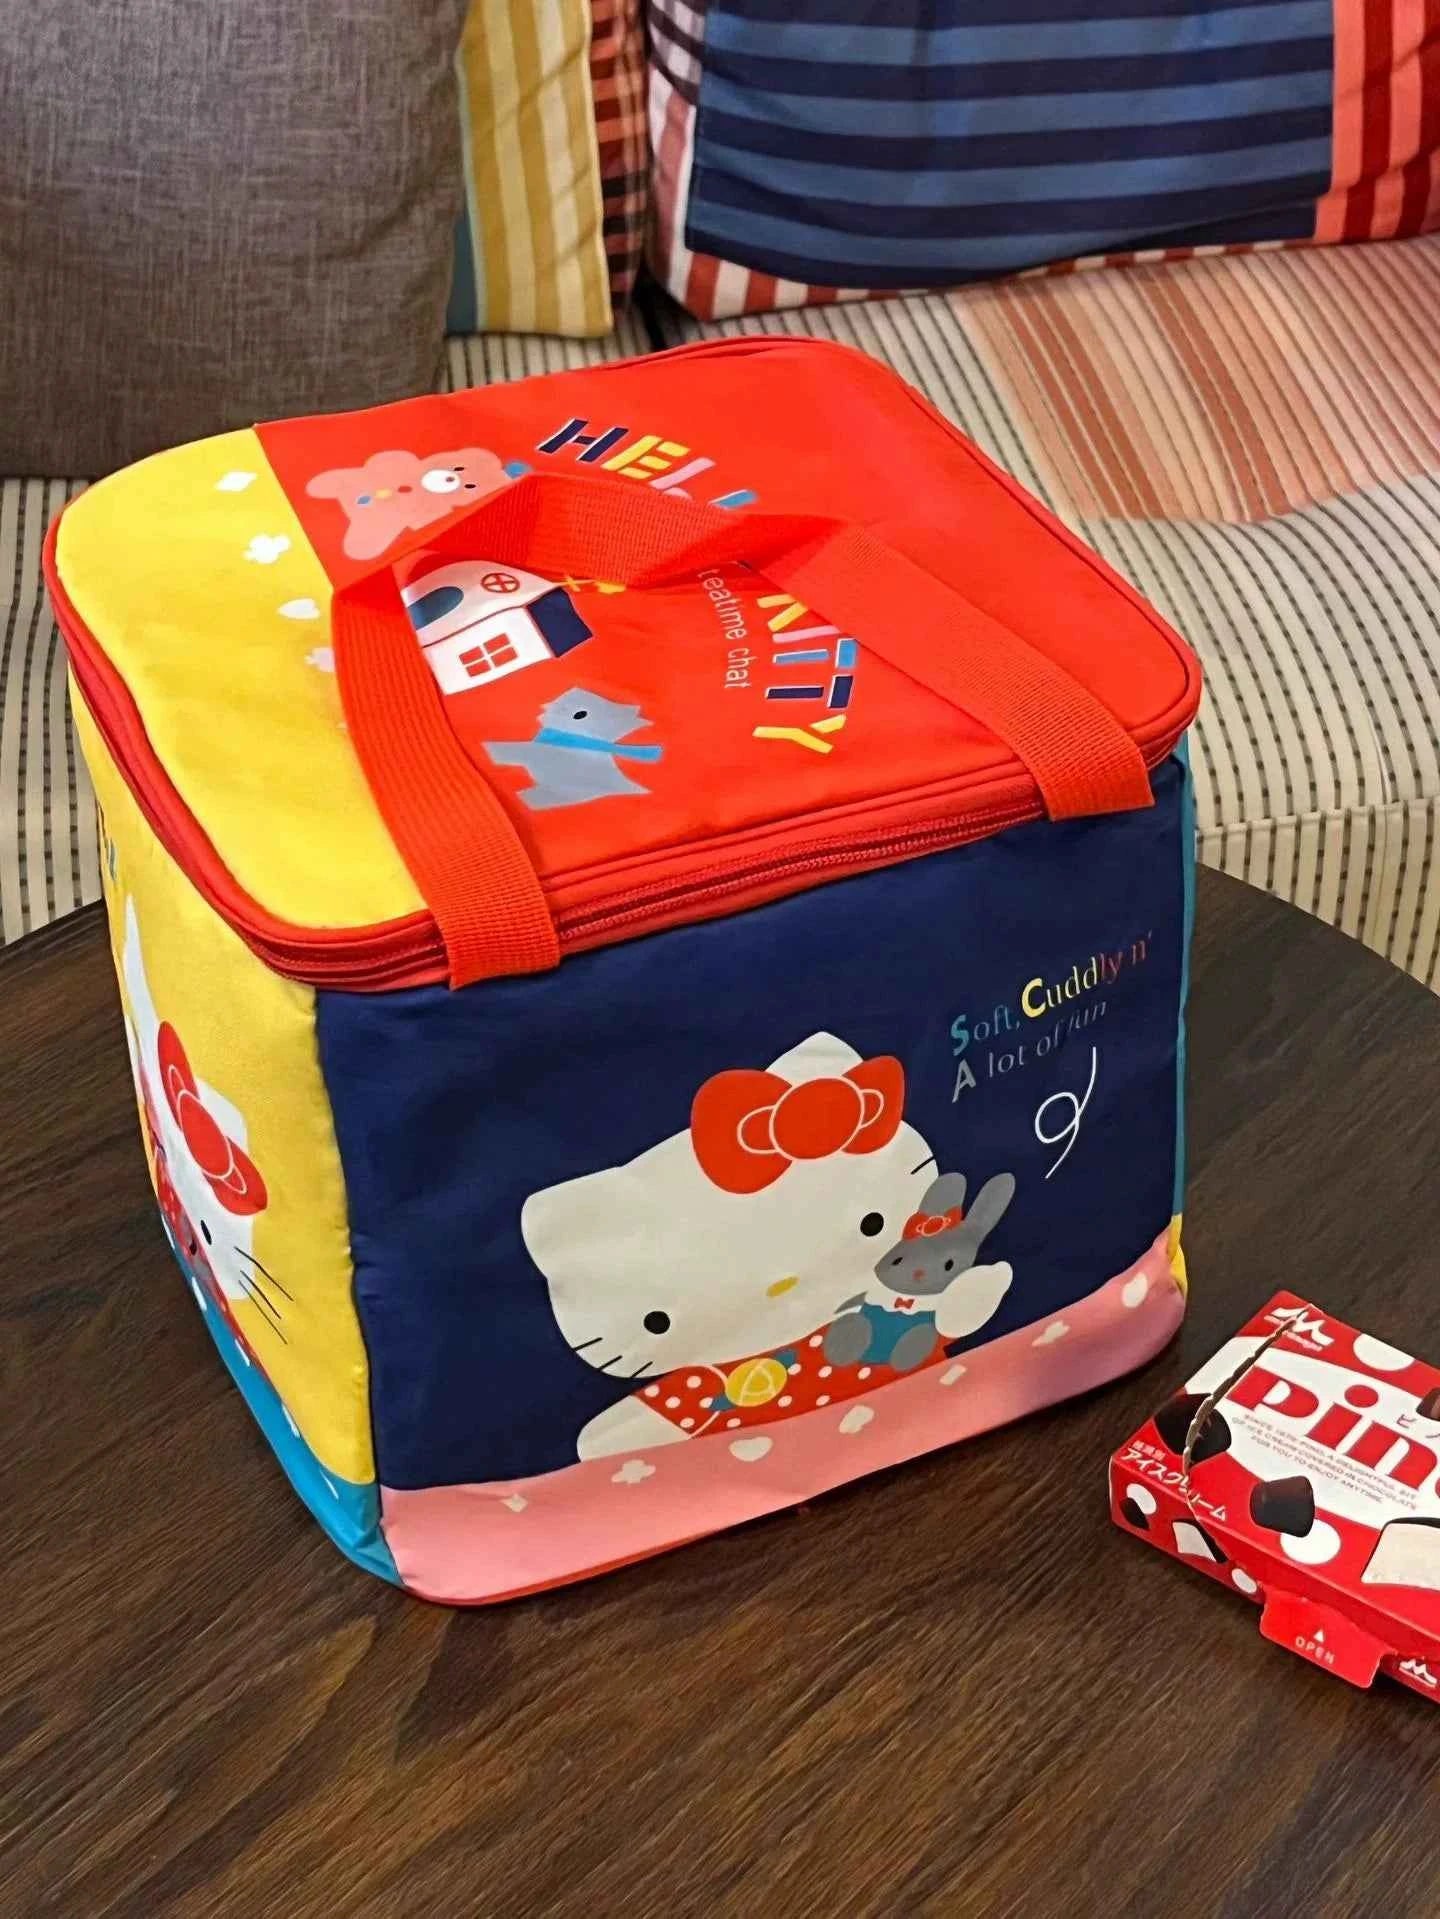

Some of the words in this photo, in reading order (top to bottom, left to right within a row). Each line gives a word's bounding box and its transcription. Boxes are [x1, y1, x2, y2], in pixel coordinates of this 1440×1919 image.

[697, 569, 748, 640] teatime
[724, 647, 758, 689] chat
[950, 1004, 1021, 1057] Soft,
[1021, 951, 1124, 1018] Cuddly
[951, 1058, 977, 1104] A
[987, 1045, 1025, 1079] lot
[1036, 1018, 1065, 1058] of
[1226, 1366, 1440, 1500] pin
[1295, 1635, 1335, 1665] OPEN
